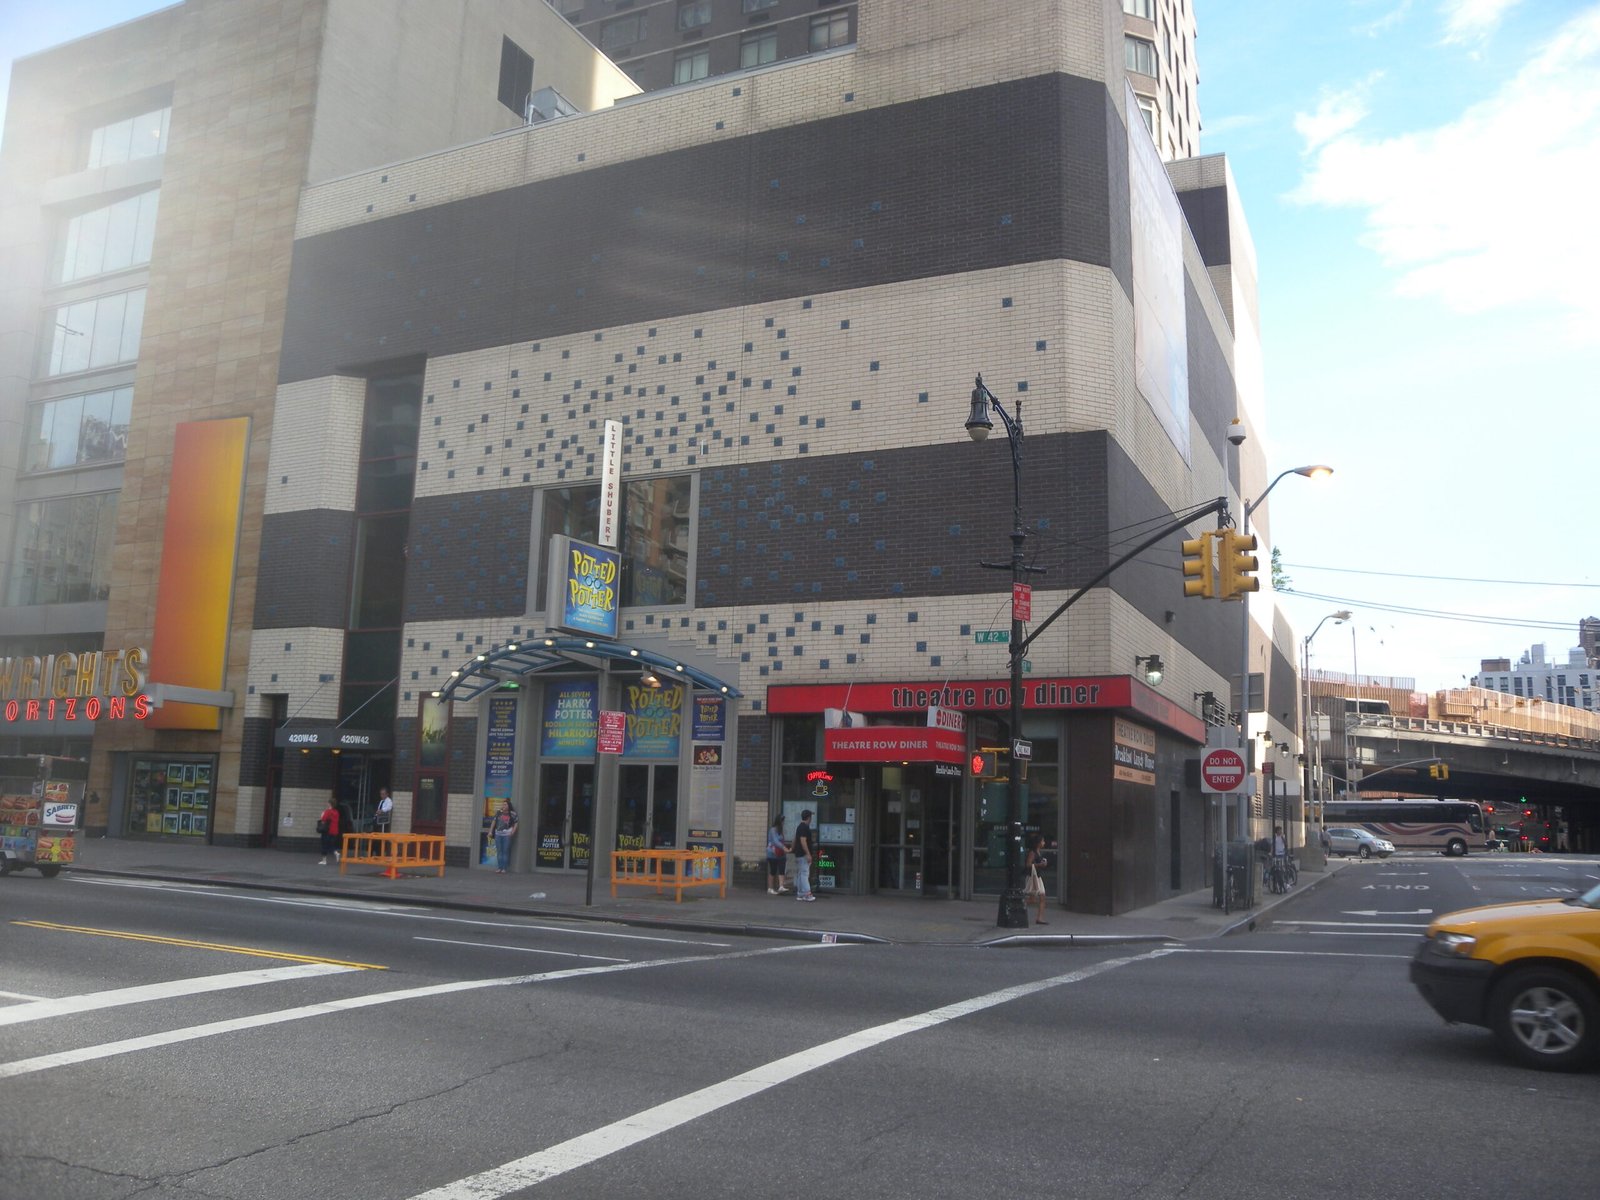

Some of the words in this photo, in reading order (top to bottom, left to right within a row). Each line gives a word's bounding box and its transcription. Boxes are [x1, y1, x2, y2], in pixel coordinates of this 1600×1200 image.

[605, 482, 613, 542] SHUBERT
[571, 549, 616, 584] POTTED
[569, 578, 615, 612] POTTER
[977, 632, 984, 642] W
[987, 632, 999, 642] 42
[627, 685, 683, 714] POTTED
[892, 686, 976, 708] theatre
[1035, 682, 1100, 706] diner
[557, 698, 592, 708] HARRY
[554, 709, 593, 719] POTTER
[942, 710, 962, 730] DINER
[626, 712, 681, 743] POTTER
[288, 734, 318, 743] 420W42
[548, 729, 598, 738] HILARIOUS
[341, 735, 369, 744] 420W42
[832, 741, 871, 749] THEATRE
[873, 740, 897, 749] ROW
[900, 740, 928, 749] DINER
[1210, 757, 1220, 765] DO
[1223, 757, 1237, 765] NOT
[1212, 775, 1236, 784] ENTER
